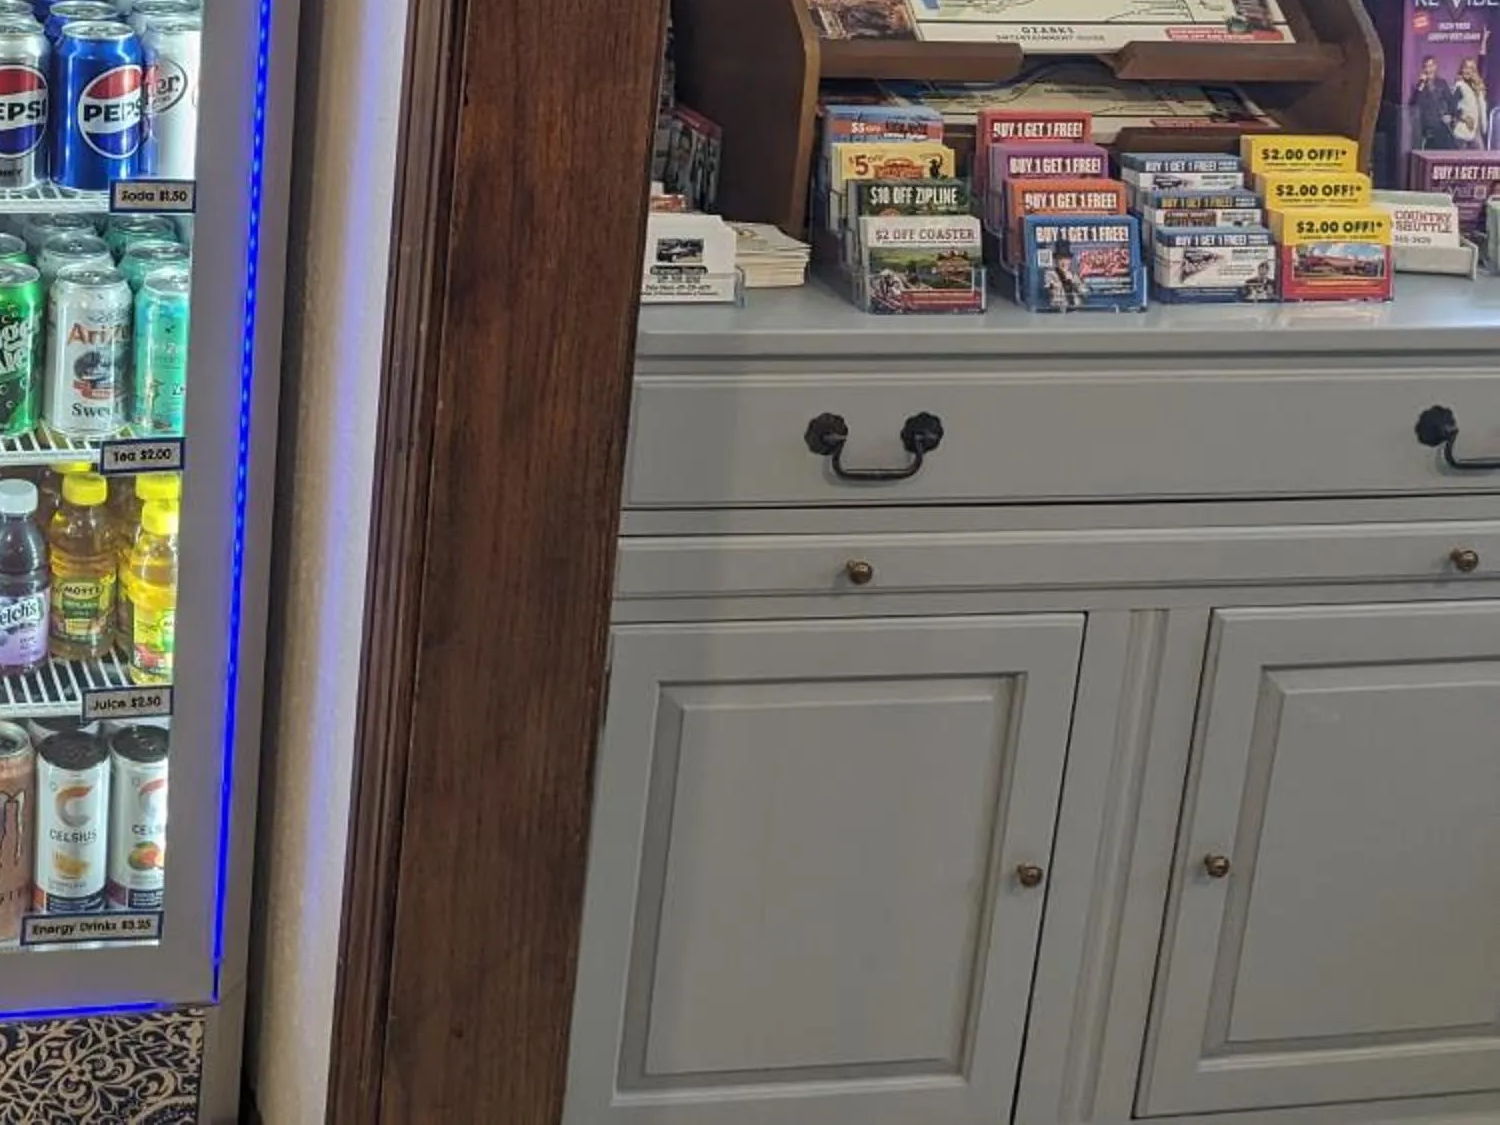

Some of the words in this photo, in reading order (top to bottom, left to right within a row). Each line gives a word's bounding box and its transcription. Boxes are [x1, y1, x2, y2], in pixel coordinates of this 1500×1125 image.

[993, 123, 1015, 137] BUY
[1024, 123, 1045, 137] GET
[1053, 123, 1083, 137] FREE!
[1261, 148, 1303, 160] $2.00
[1010, 157, 1033, 174] BUY
[1043, 157, 1063, 174] GET
[1073, 157, 1102, 174] FREE!
[121, 190, 154, 202] Soda
[870, 186, 889, 204] $10
[893, 186, 913, 203] OFF
[916, 186, 957, 204] ZIPLINE
[1275, 184, 1318, 196] $2.00
[1025, 192, 1047, 208] BUY
[1057, 192, 1077, 208] GET
[1086, 192, 1117, 208] FREE!
[1296, 220, 1338, 233] $2.00
[919, 228, 975, 240] COASTER
[1036, 227, 1058, 241] BUY
[1068, 227, 1089, 241] GET
[1099, 227, 1129, 241] FREE!
[114, 450, 136, 463] Tea
[140, 447, 172, 461] $2.00
[93, 697, 126, 710] Juice
[50, 829, 97, 843] CELSIUS
[32, 924, 75, 936] Energy
[80, 920, 117, 932] Drinks
